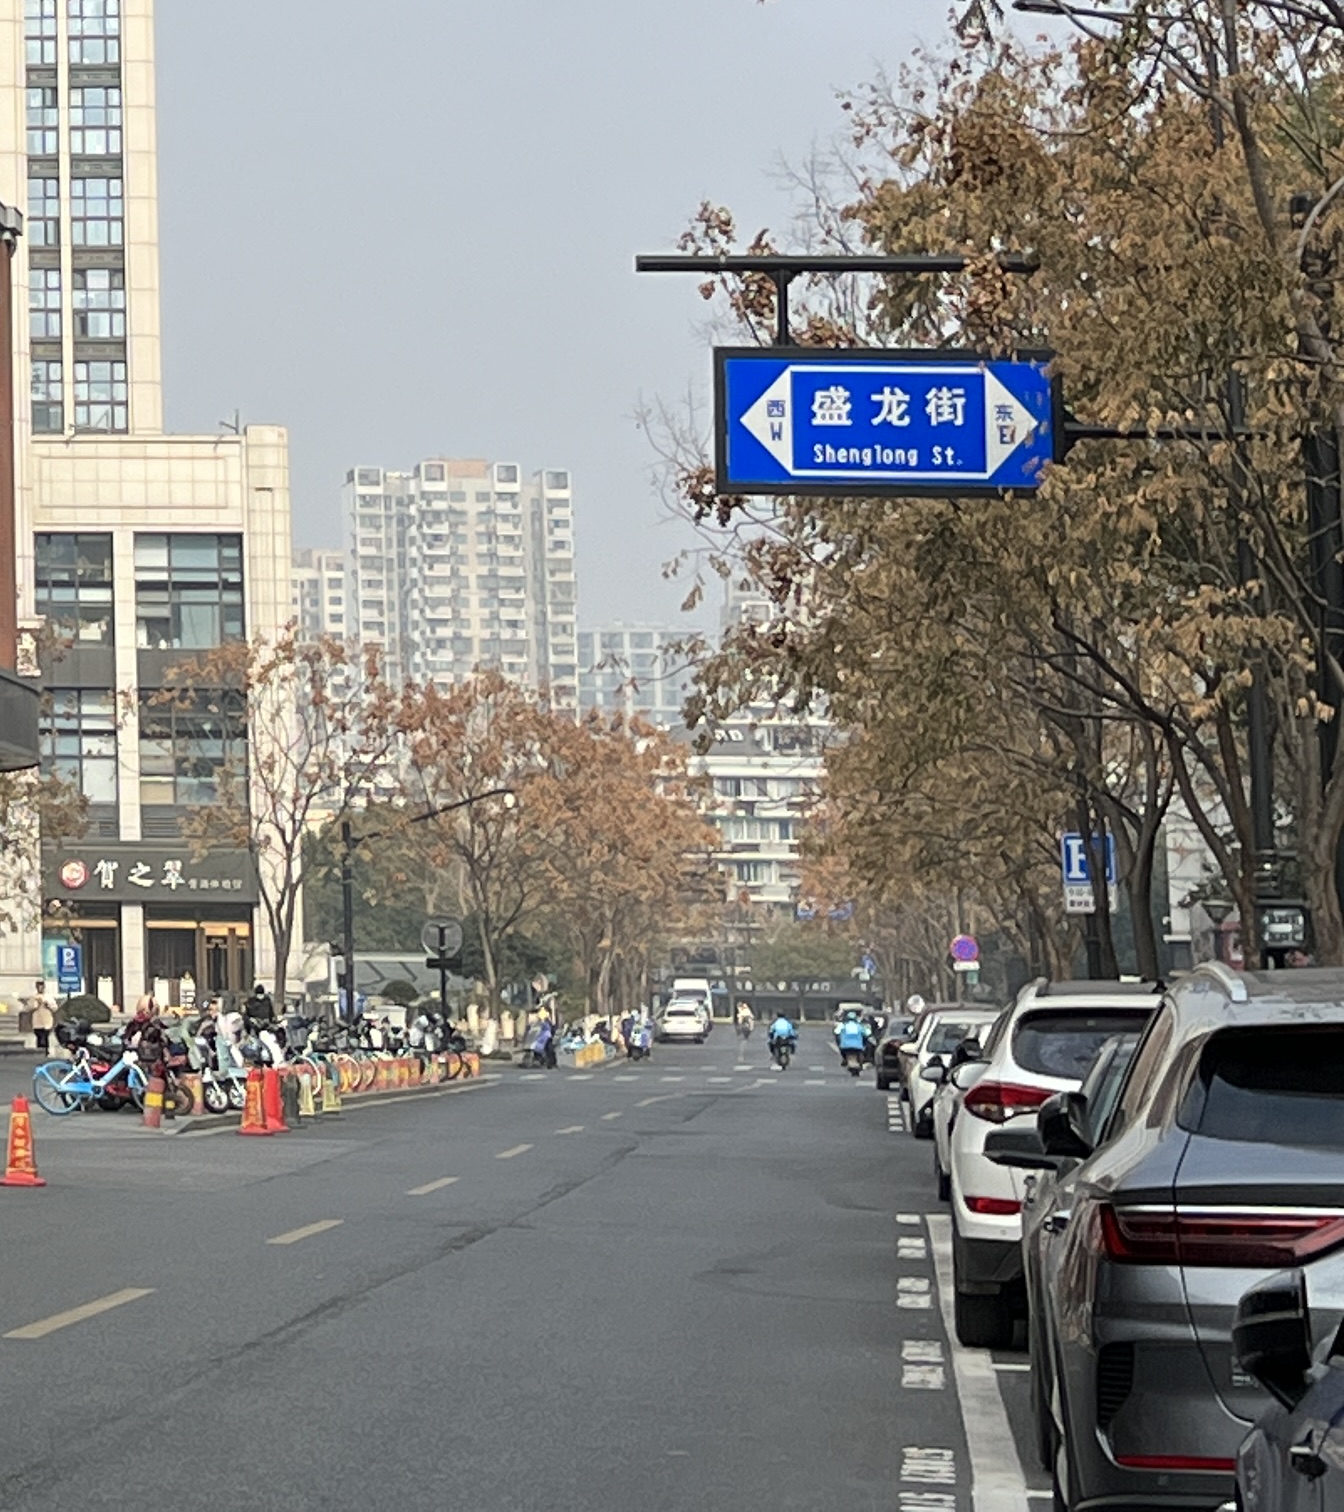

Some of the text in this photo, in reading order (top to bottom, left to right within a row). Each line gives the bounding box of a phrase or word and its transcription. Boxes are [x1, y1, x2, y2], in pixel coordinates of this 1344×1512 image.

[766, 399, 786, 418] 西
[811, 386, 967, 426] 盛龙街
[770, 423, 783, 441] W
[999, 425, 1015, 445] E
[813, 444, 963, 466] Shenglong St.
